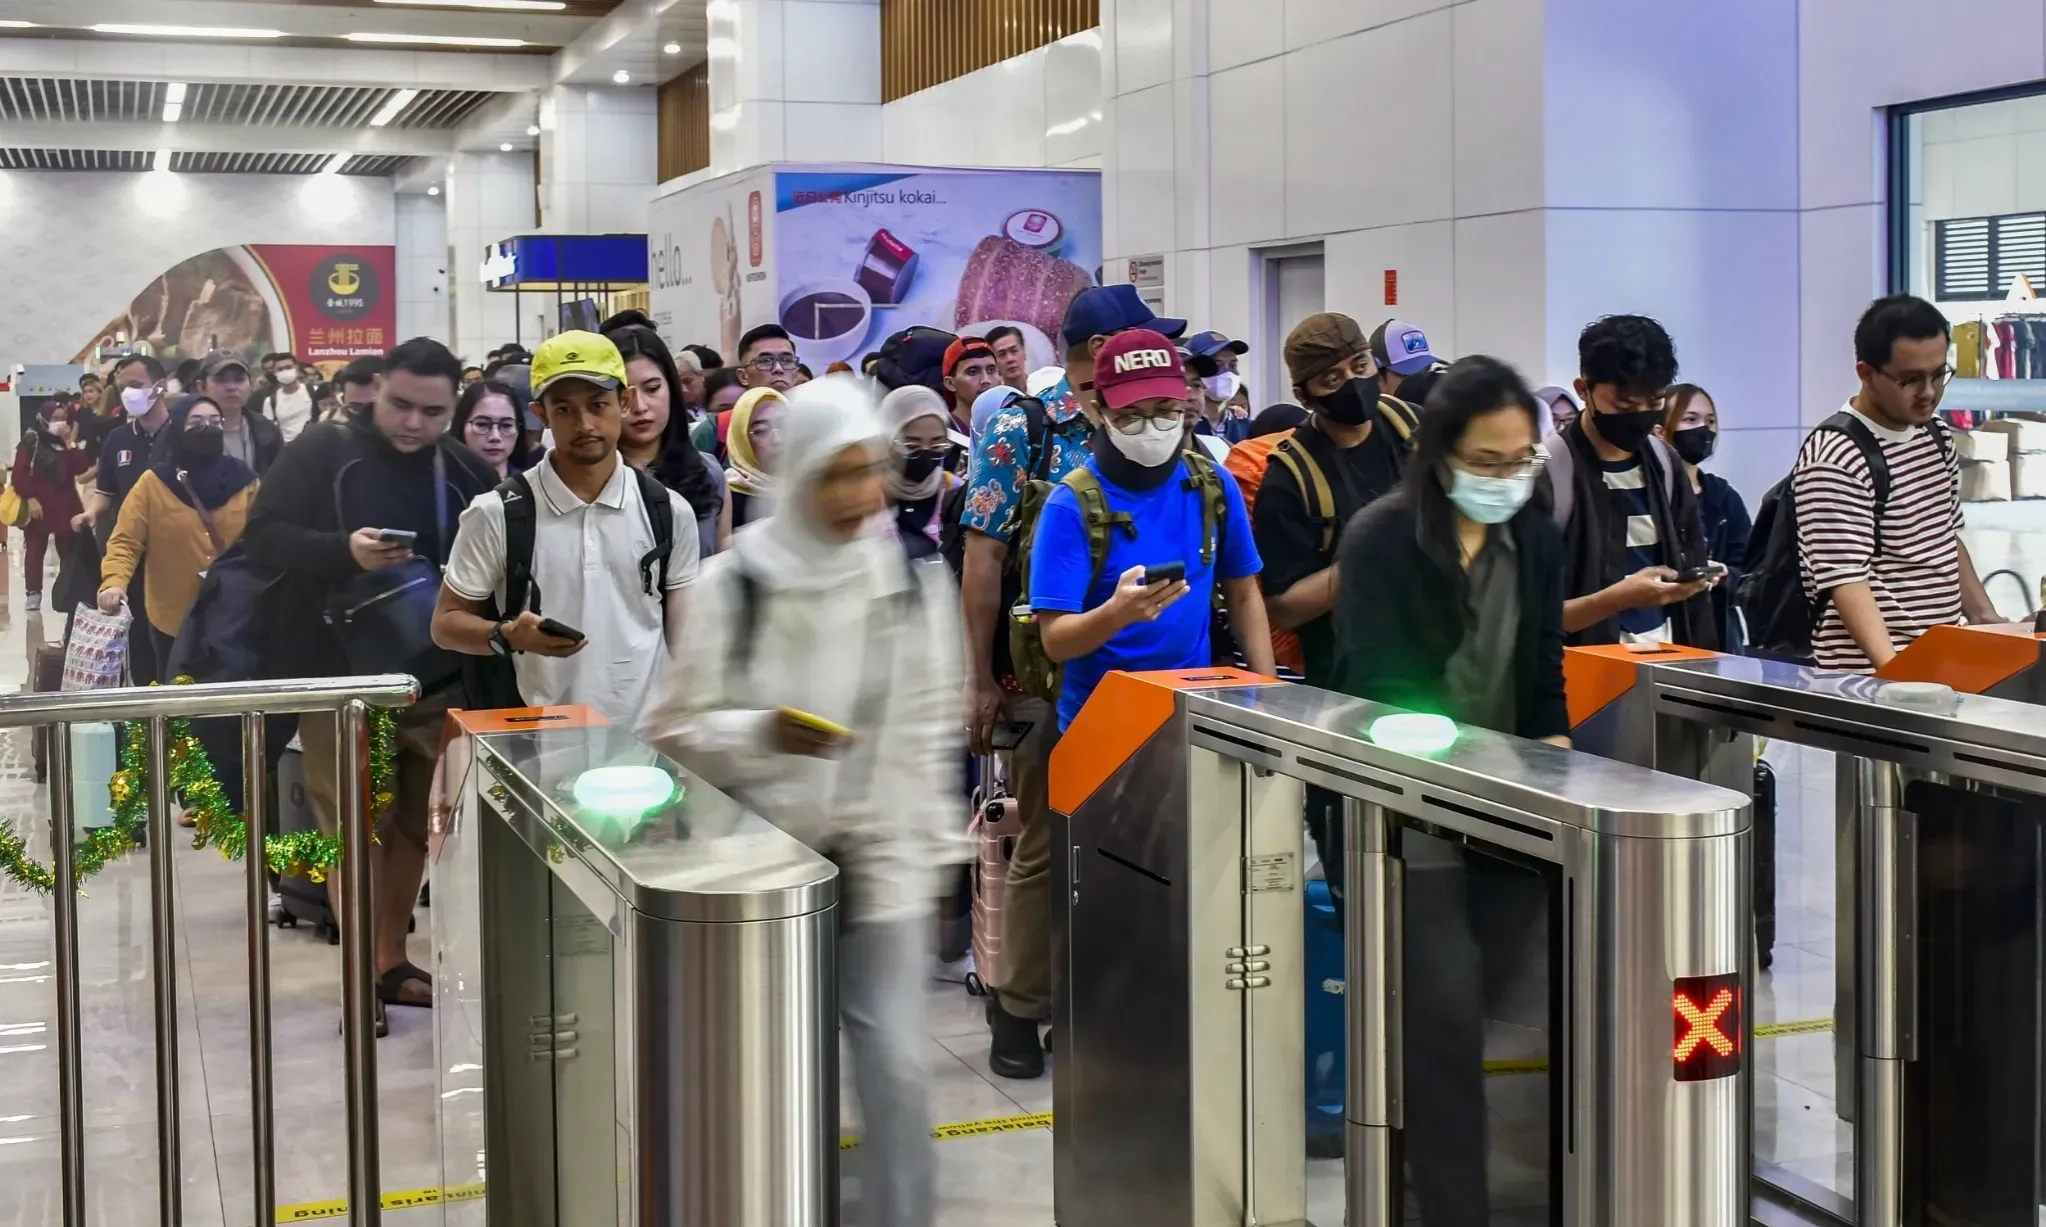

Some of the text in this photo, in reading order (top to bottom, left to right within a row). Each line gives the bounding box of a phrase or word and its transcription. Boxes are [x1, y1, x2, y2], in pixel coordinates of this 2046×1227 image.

[844, 190, 894, 207] Kinjitsu
[899, 189, 947, 205] kokai...
[308, 327, 384, 345] 兰州拉面
[308, 347, 384, 356] Lanzhou Lamian
[1113, 348, 1172, 374] NERD
[946, 1120, 1051, 1137] belakang
